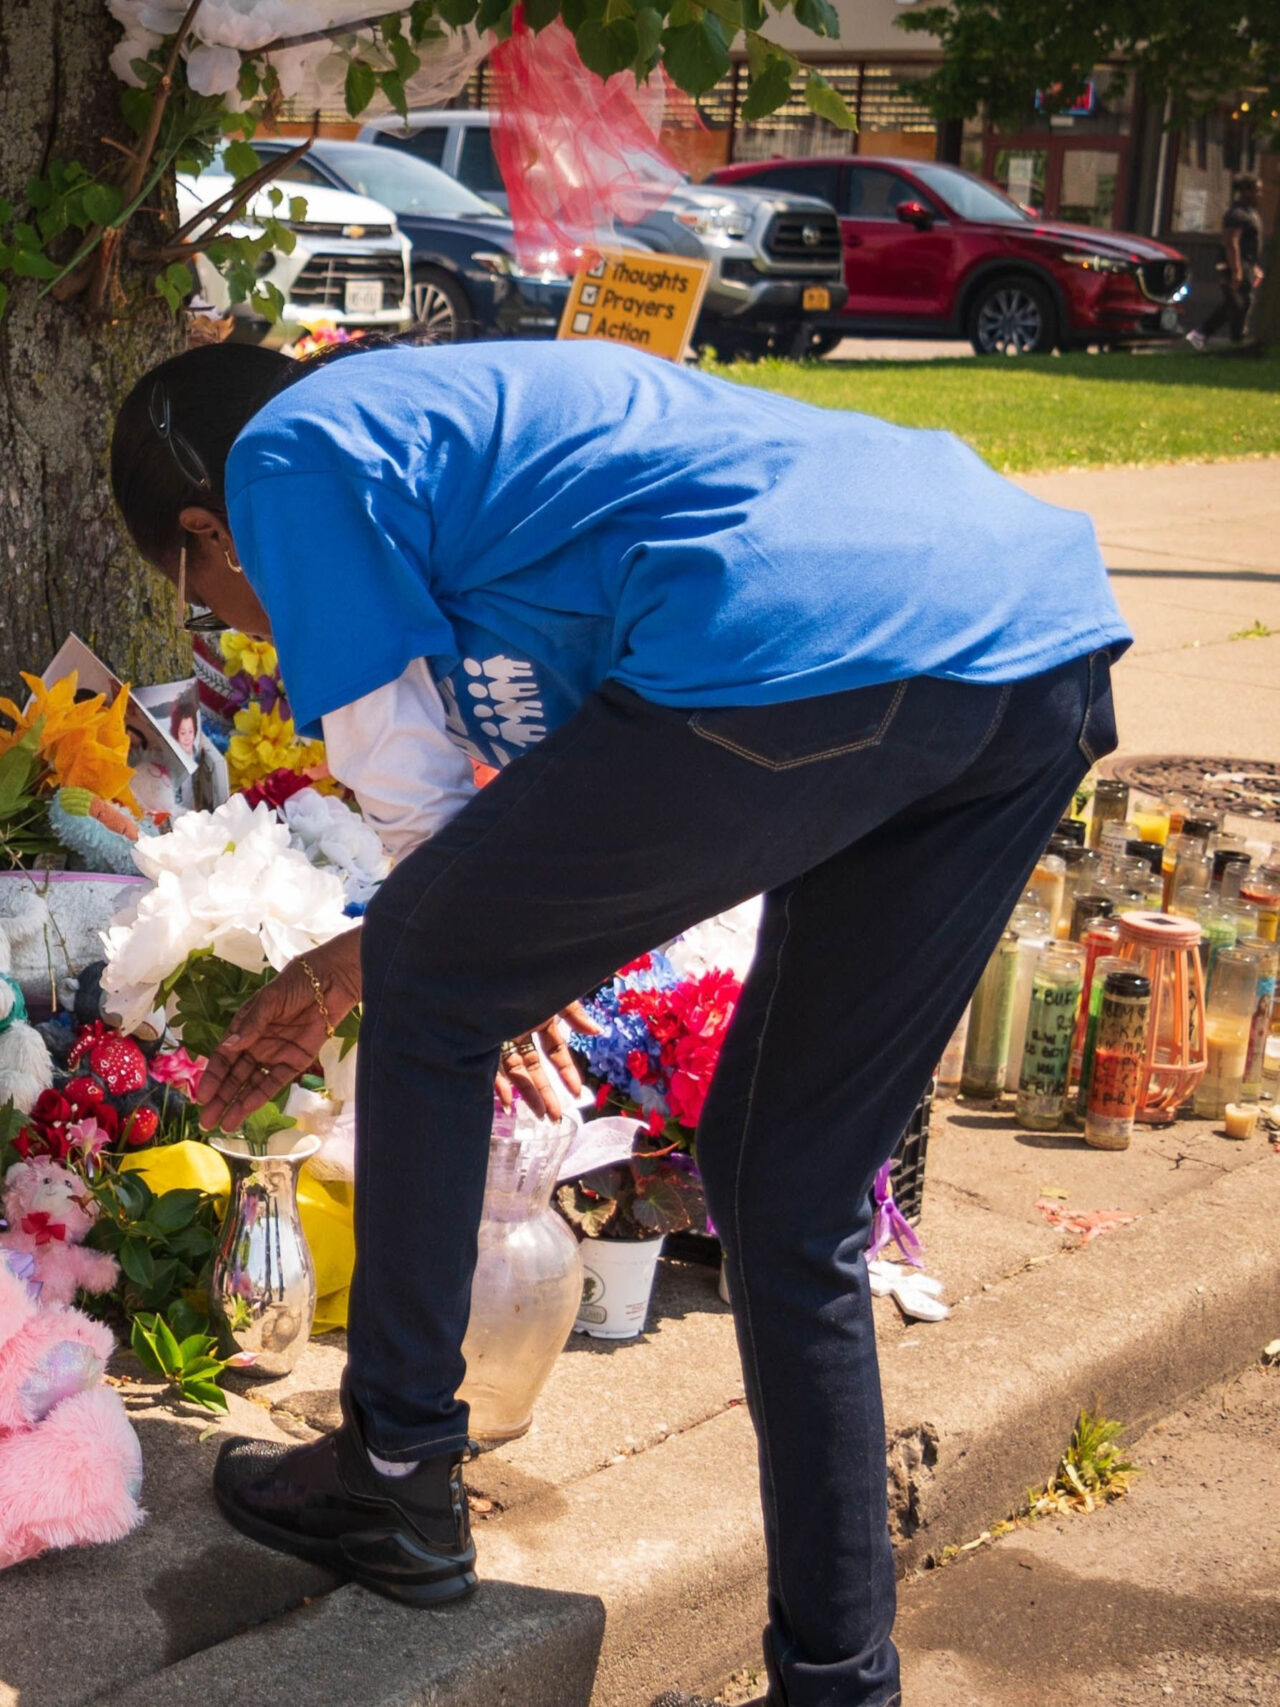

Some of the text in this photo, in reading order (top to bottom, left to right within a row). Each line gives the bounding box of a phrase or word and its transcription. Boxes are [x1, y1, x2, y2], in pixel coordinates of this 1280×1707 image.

[612, 262, 689, 293] Thoughts
[602, 289, 675, 320] Prayers
[594, 317, 651, 344] Action
